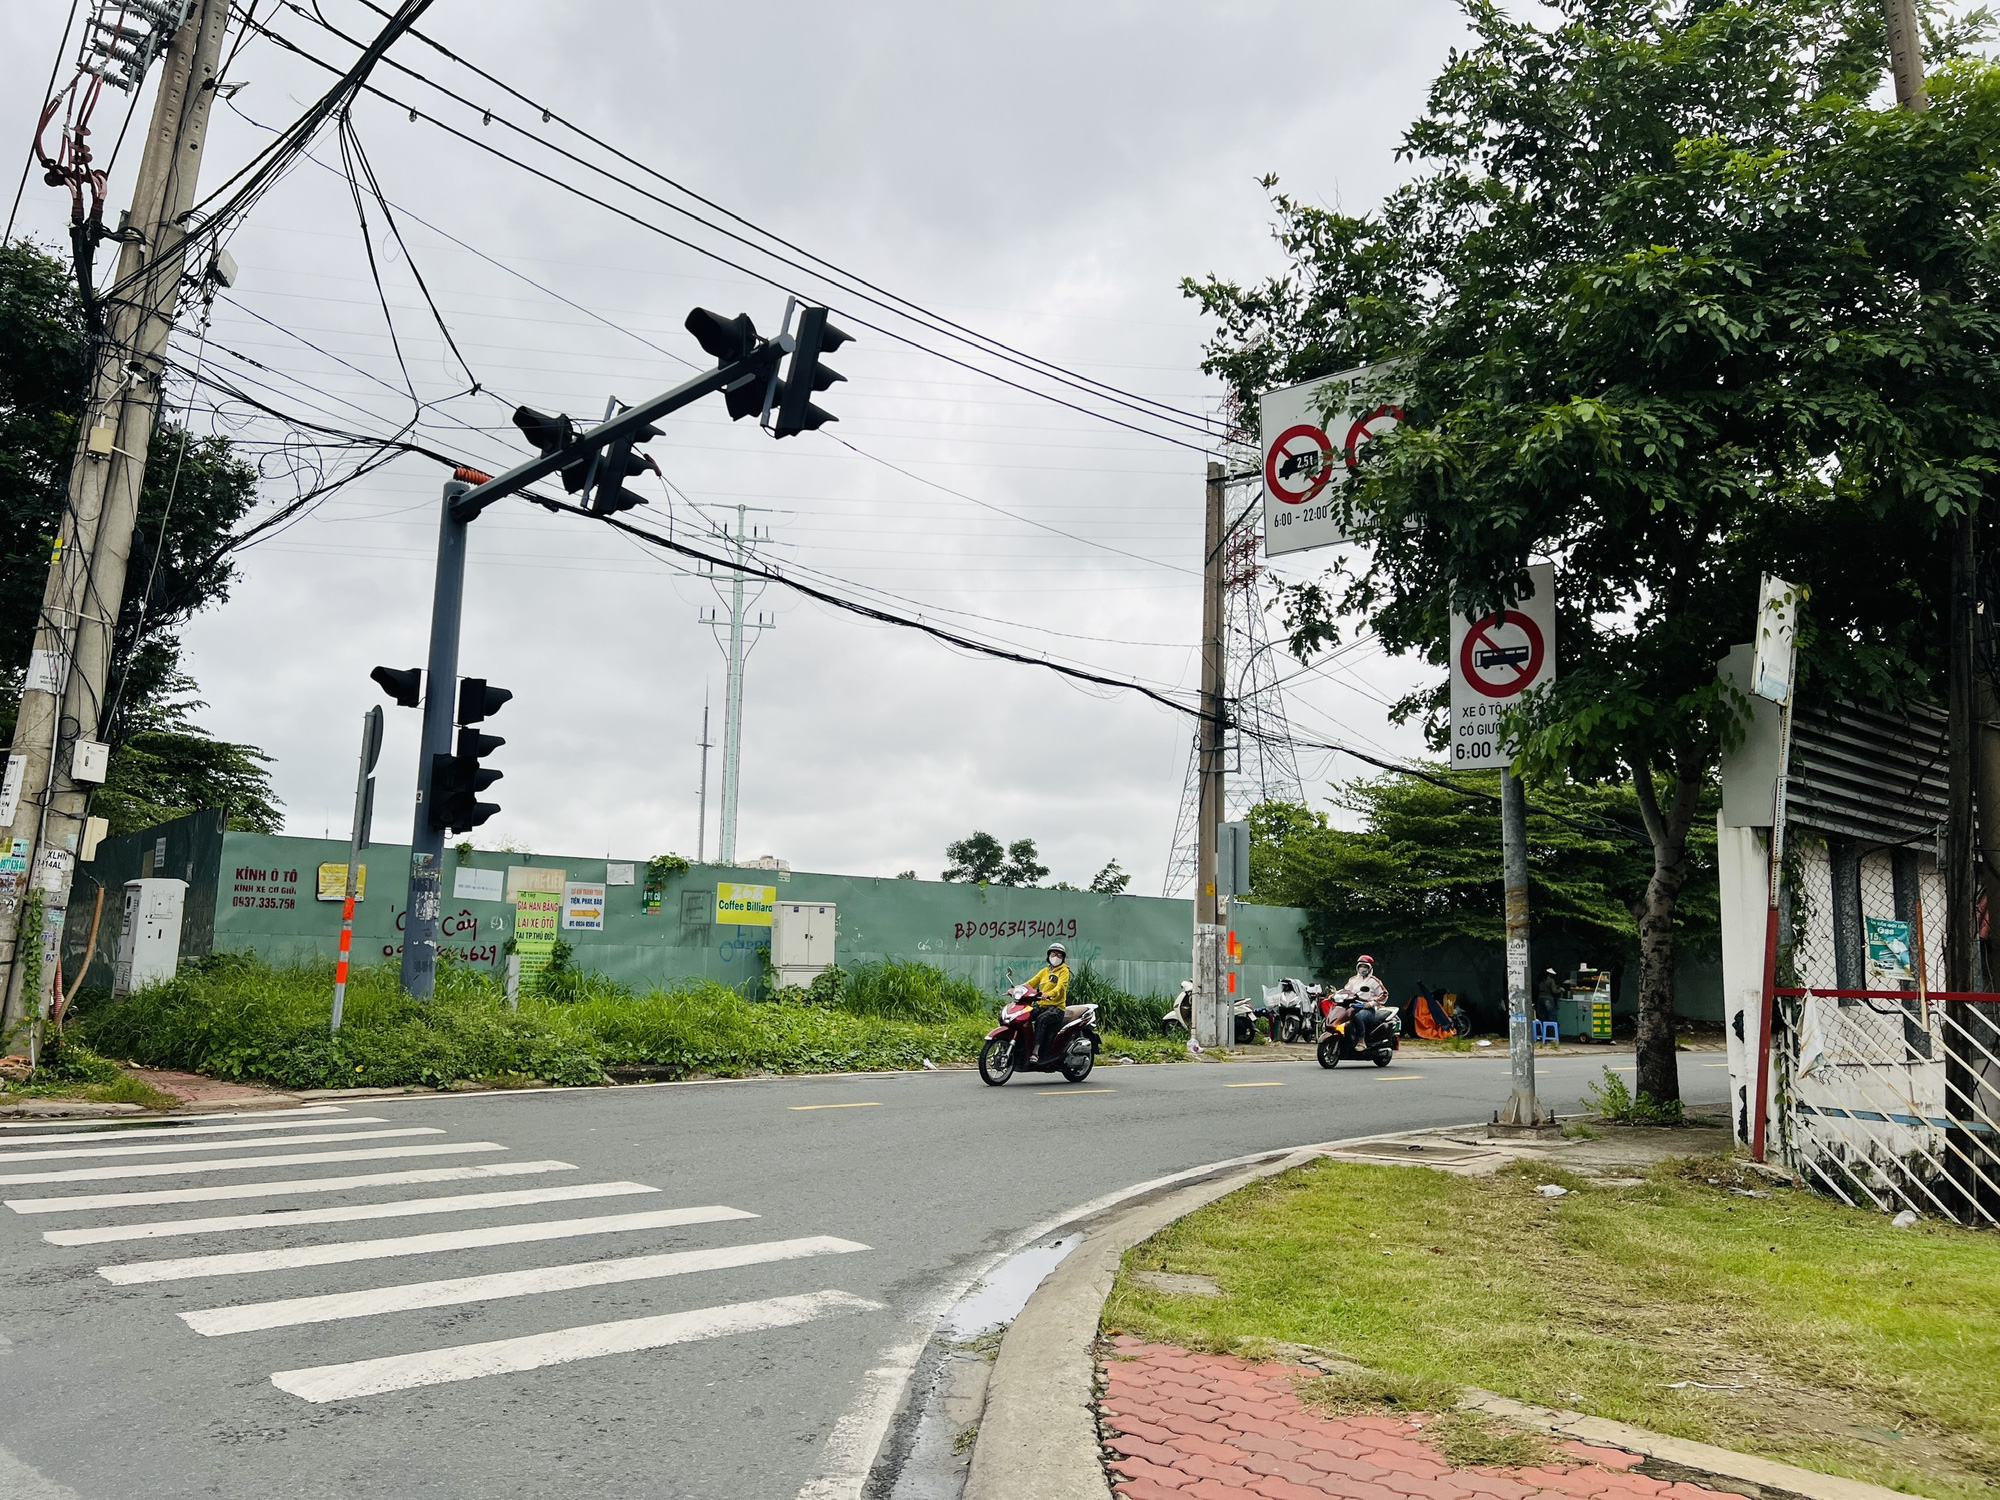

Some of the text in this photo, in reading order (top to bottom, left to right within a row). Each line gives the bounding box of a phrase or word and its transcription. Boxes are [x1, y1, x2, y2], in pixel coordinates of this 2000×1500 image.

[1274, 512, 1292, 528] 6:00
[1303, 505, 1328, 522] 22:00
[1462, 706, 1476, 718] XE
[1478, 703, 1486, 716] Ô
[1489, 702, 1502, 716] TÔ
[1459, 722, 1474, 737] CÓ
[1456, 741, 1491, 760] 6:00
[46, 850, 68, 861] XLHN
[235, 866, 298, 883] KÍNH Ô TÔ
[256, 885, 266, 893] XE
[731, 885, 764, 901] 268
[517, 900, 527, 911] GIA
[543, 898, 559, 913] BẢNG
[718, 899, 744, 911] Coffee
[517, 915, 529, 928] LÁI
[531, 918, 539, 928] XE
